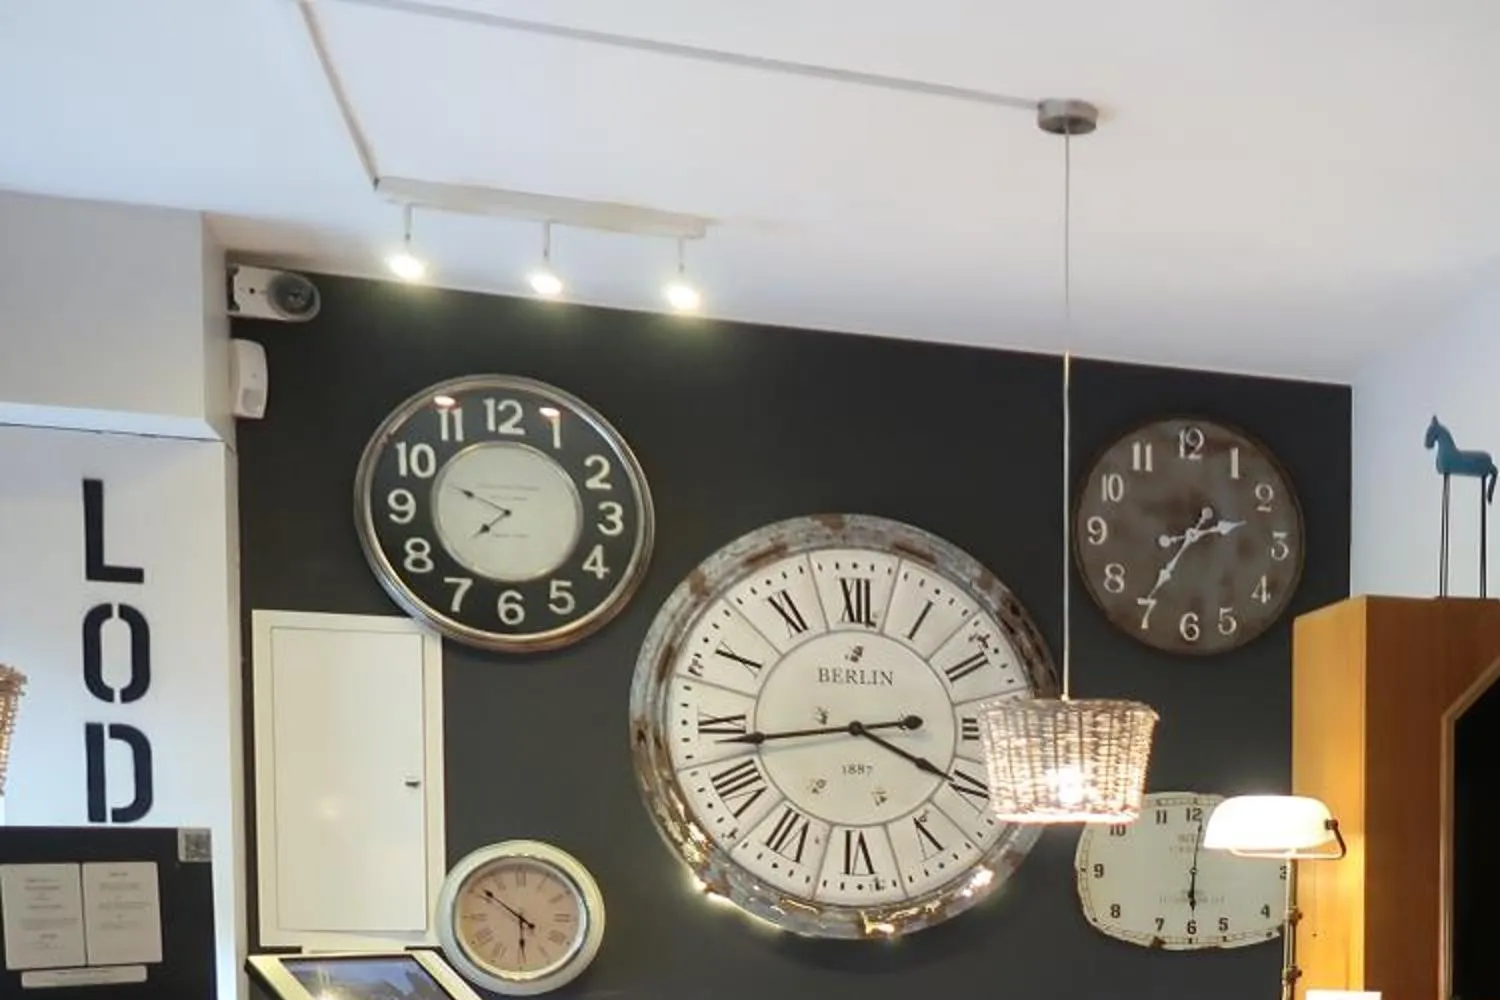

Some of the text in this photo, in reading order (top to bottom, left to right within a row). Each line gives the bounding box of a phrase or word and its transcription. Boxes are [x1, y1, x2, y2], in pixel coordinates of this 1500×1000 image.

[438, 407, 464, 441] 11
[483, 398, 525, 435] 12
[396, 442, 436, 478] 10
[1132, 441, 1153, 472] 11
[1179, 427, 1205, 460] 12
[584, 455, 612, 490] 2
[1230, 447, 1239, 480] 1
[1101, 473, 1124, 502] 10
[1254, 483, 1274, 512] 2
[387, 488, 416, 524] 9
[597, 501, 624, 536] 3
[1087, 515, 1108, 545] 9
[1271, 531, 1290, 561] 3
[403, 537, 434, 574] 8
[582, 544, 610, 579] 4
[1104, 563, 1126, 593] 8
[1251, 575, 1271, 604] 4
[444, 577, 473, 613] 7
[497, 589, 525, 625] 6
[548, 580, 575, 615] 5
[839, 578, 871, 624] XII
[767, 590, 809, 639] XI
[1137, 597, 1157, 630] 7
[1179, 612, 1200, 641] 6
[1217, 607, 1238, 635] 5
[715, 640, 763, 680] X
[945, 649, 990, 685] II
[817, 667, 894, 687] BERLIN
[708, 758, 768, 819] VIII
[1155, 809, 1167, 825] 11
[1185, 807, 1202, 823] 12
[766, 803, 810, 864] VII
[841, 829, 877, 876] VI
[1093, 863, 1104, 879] 9
[1111, 903, 1121, 919] 8
[1154, 917, 1165, 932] 7
[1187, 920, 1197, 935] 6
[1218, 917, 1229, 932] 5
[1260, 904, 1271, 918] 4
